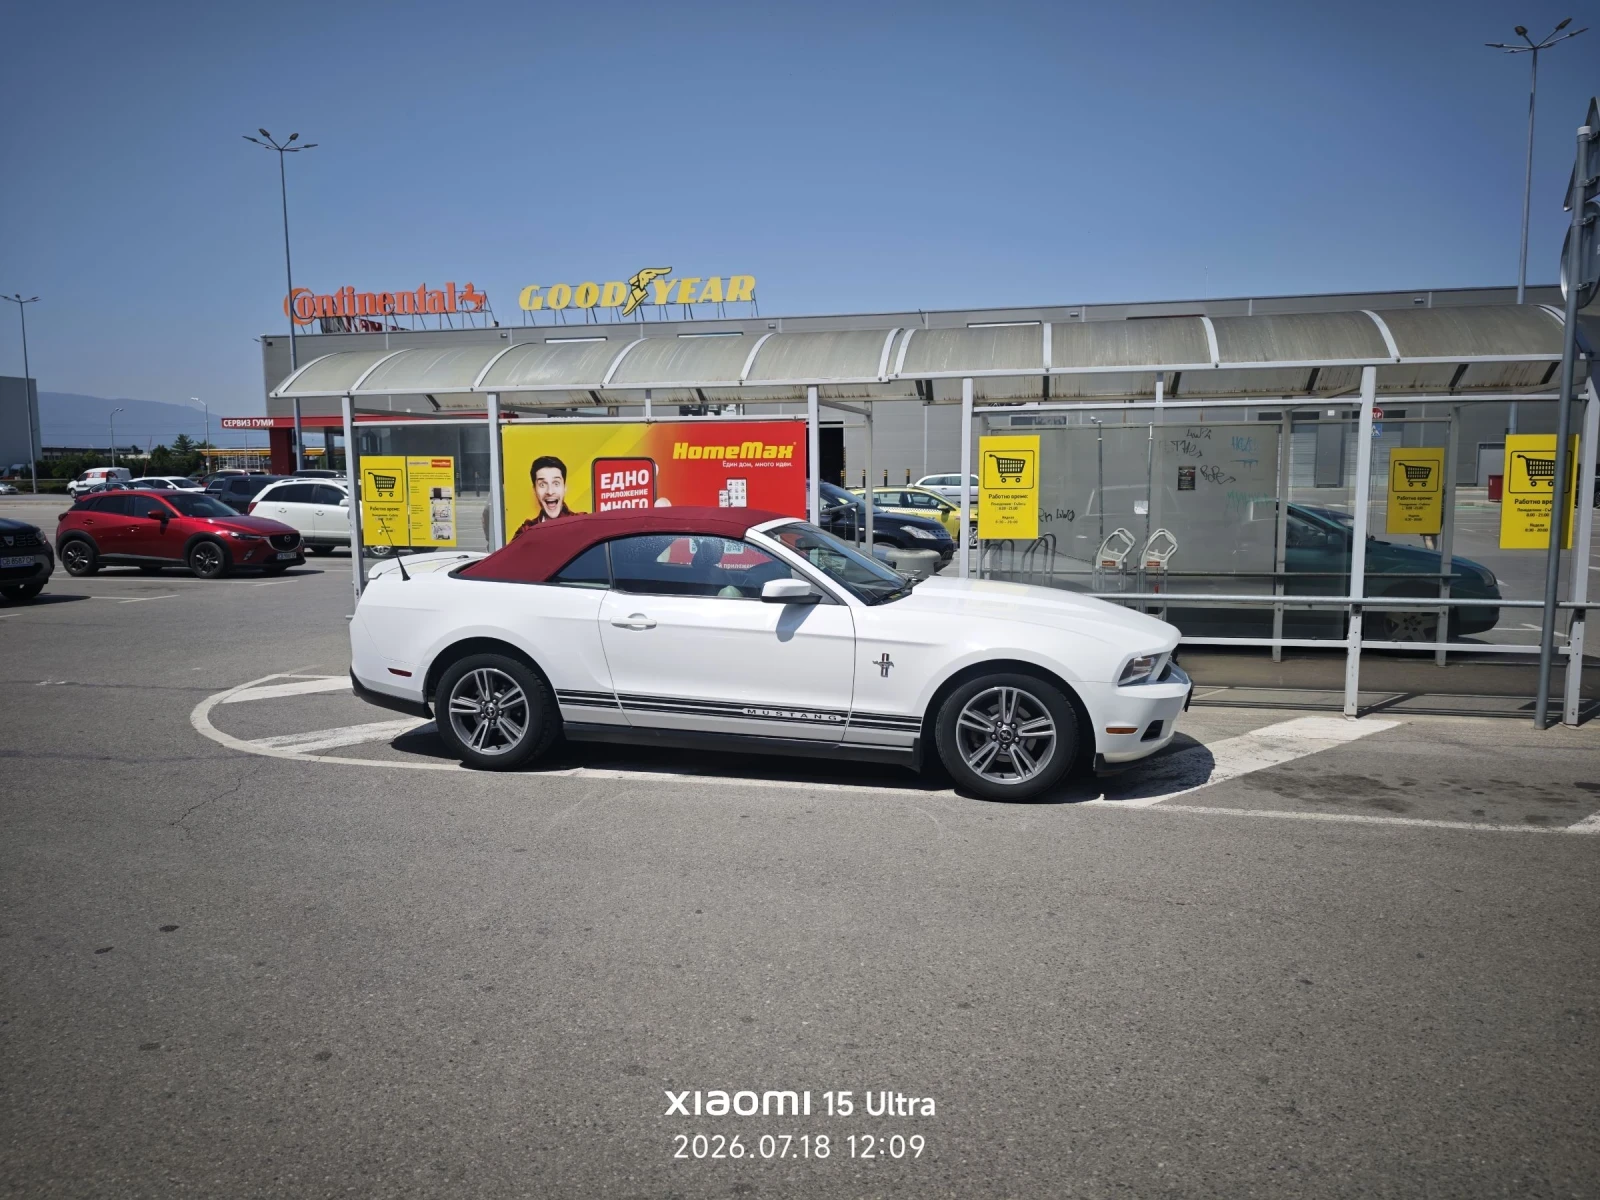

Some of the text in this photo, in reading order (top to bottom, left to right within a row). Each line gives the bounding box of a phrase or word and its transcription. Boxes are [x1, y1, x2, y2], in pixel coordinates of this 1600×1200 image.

[284, 282, 457, 326] Continental
[223, 418, 274, 427] СЕРВИЗ ГУМИ
[672, 441, 794, 460] HomeMax
[722, 460, 738, 468] Един
[600, 469, 650, 491] ЕДНО
[600, 488, 649, 500] ПРИЛОЖЕНИЕ
[747, 709, 837, 721] MUSTANG
